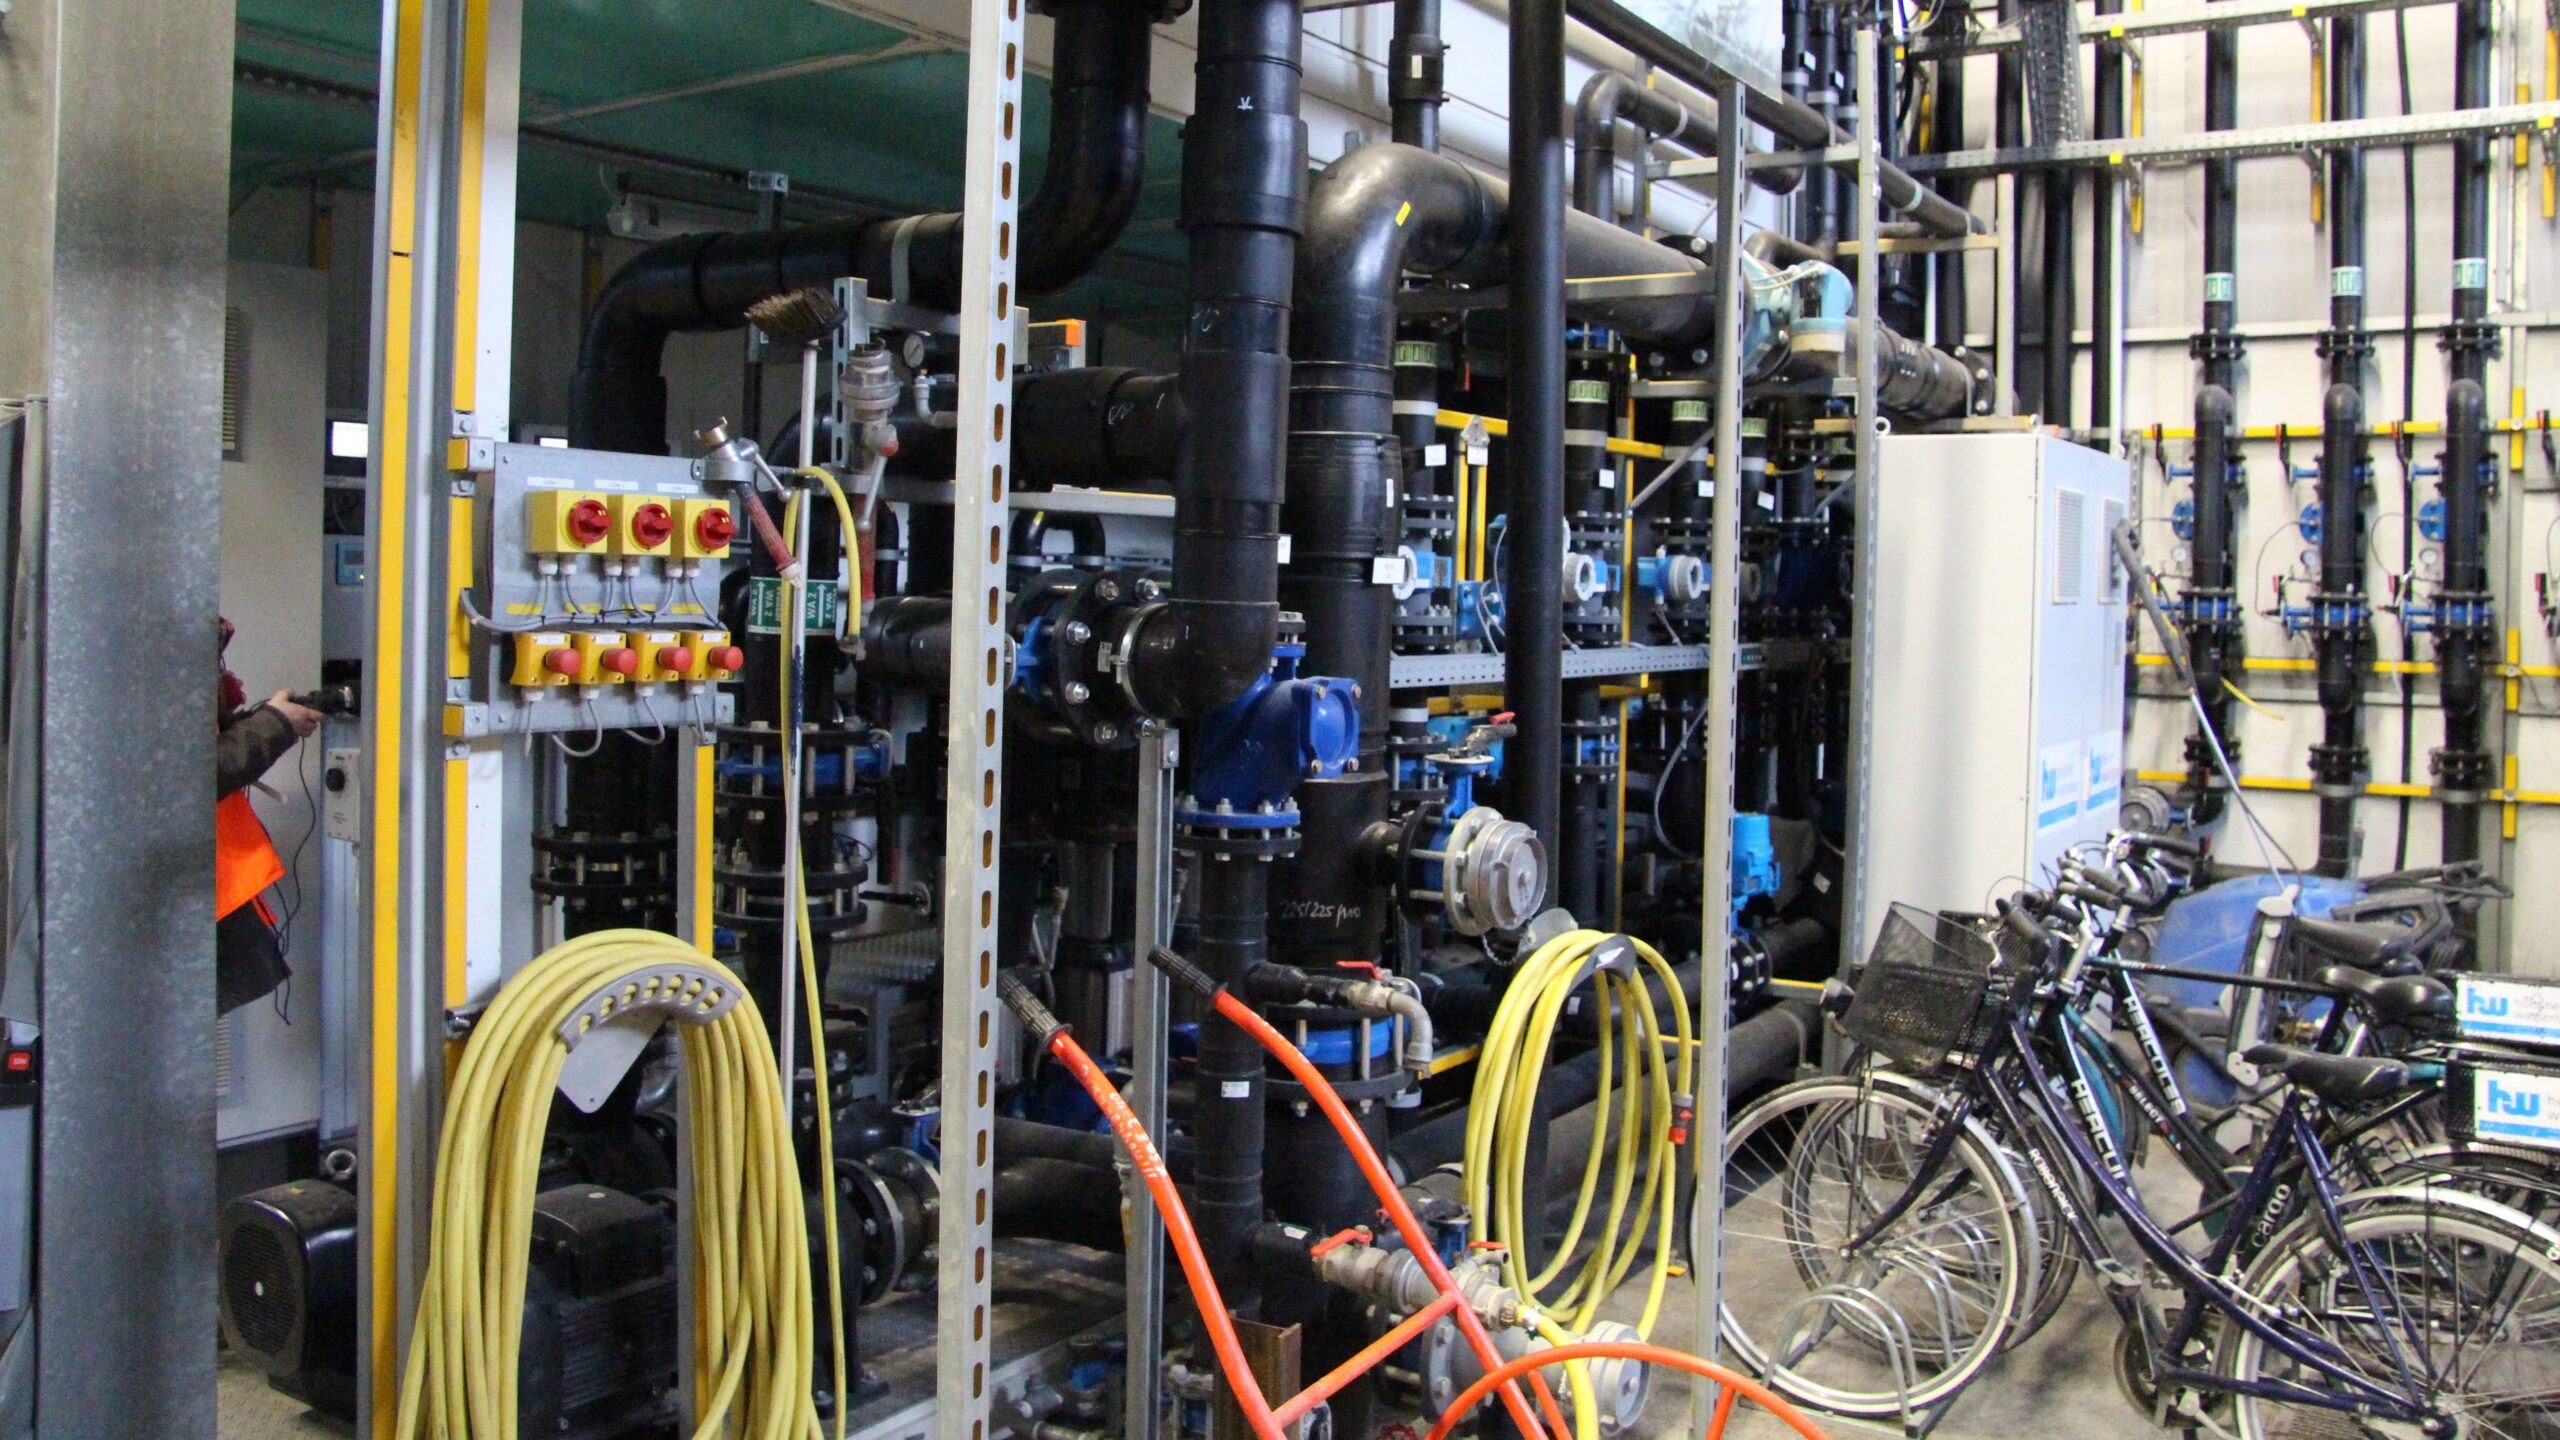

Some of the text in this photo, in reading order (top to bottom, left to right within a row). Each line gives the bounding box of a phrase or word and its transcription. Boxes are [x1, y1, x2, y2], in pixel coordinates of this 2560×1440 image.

[806, 600, 816, 619] WA
[2467, 986, 2509, 1017] hw
[2487, 1079, 2541, 1117] hw
[2251, 1184, 2292, 1247] Cargo
